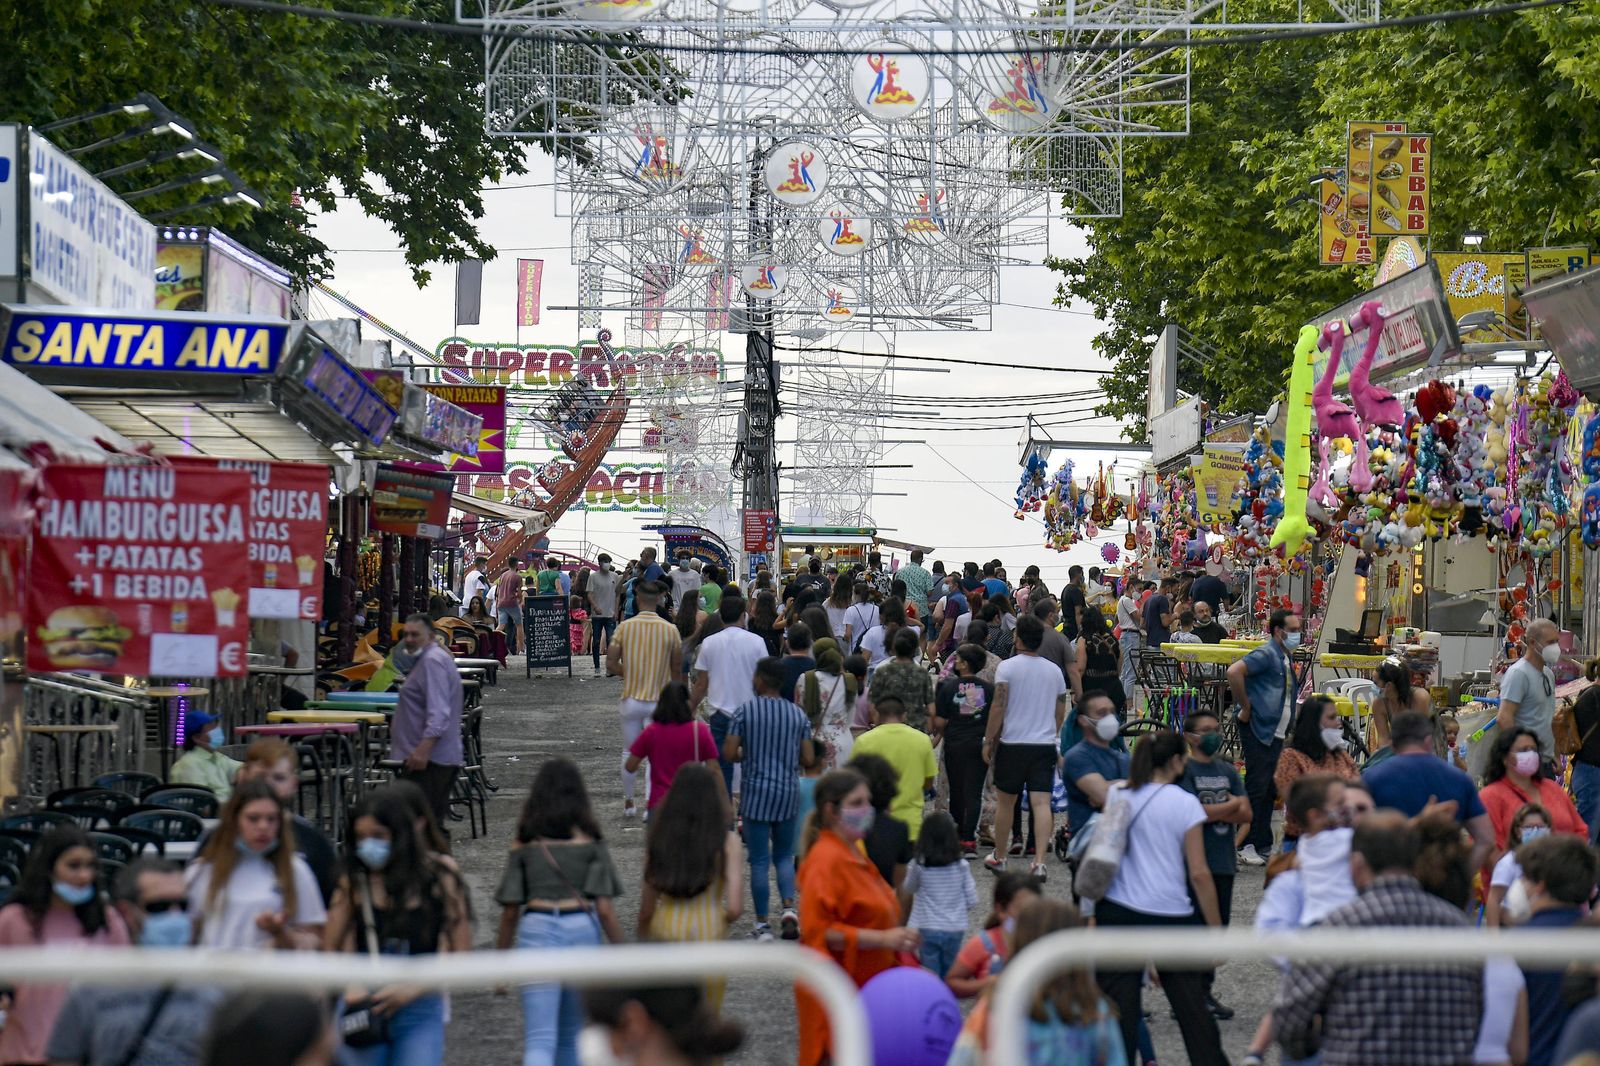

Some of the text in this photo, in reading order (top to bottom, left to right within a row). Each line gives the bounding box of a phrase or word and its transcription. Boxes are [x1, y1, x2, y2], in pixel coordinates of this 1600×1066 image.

[1406, 136, 1428, 231] KEBAB
[11, 320, 165, 365] SANTA
[174, 326, 271, 370] ANA
[441, 343, 573, 387] SUPER
[455, 387, 498, 404] PATATAS
[104, 465, 176, 500] MENU
[40, 499, 245, 543] HAMBURGUESA
[75, 544, 204, 572] +PATATAS
[68, 573, 209, 600] +1 BEBIDA
[300, 596, 318, 618] €
[218, 641, 243, 673] €
